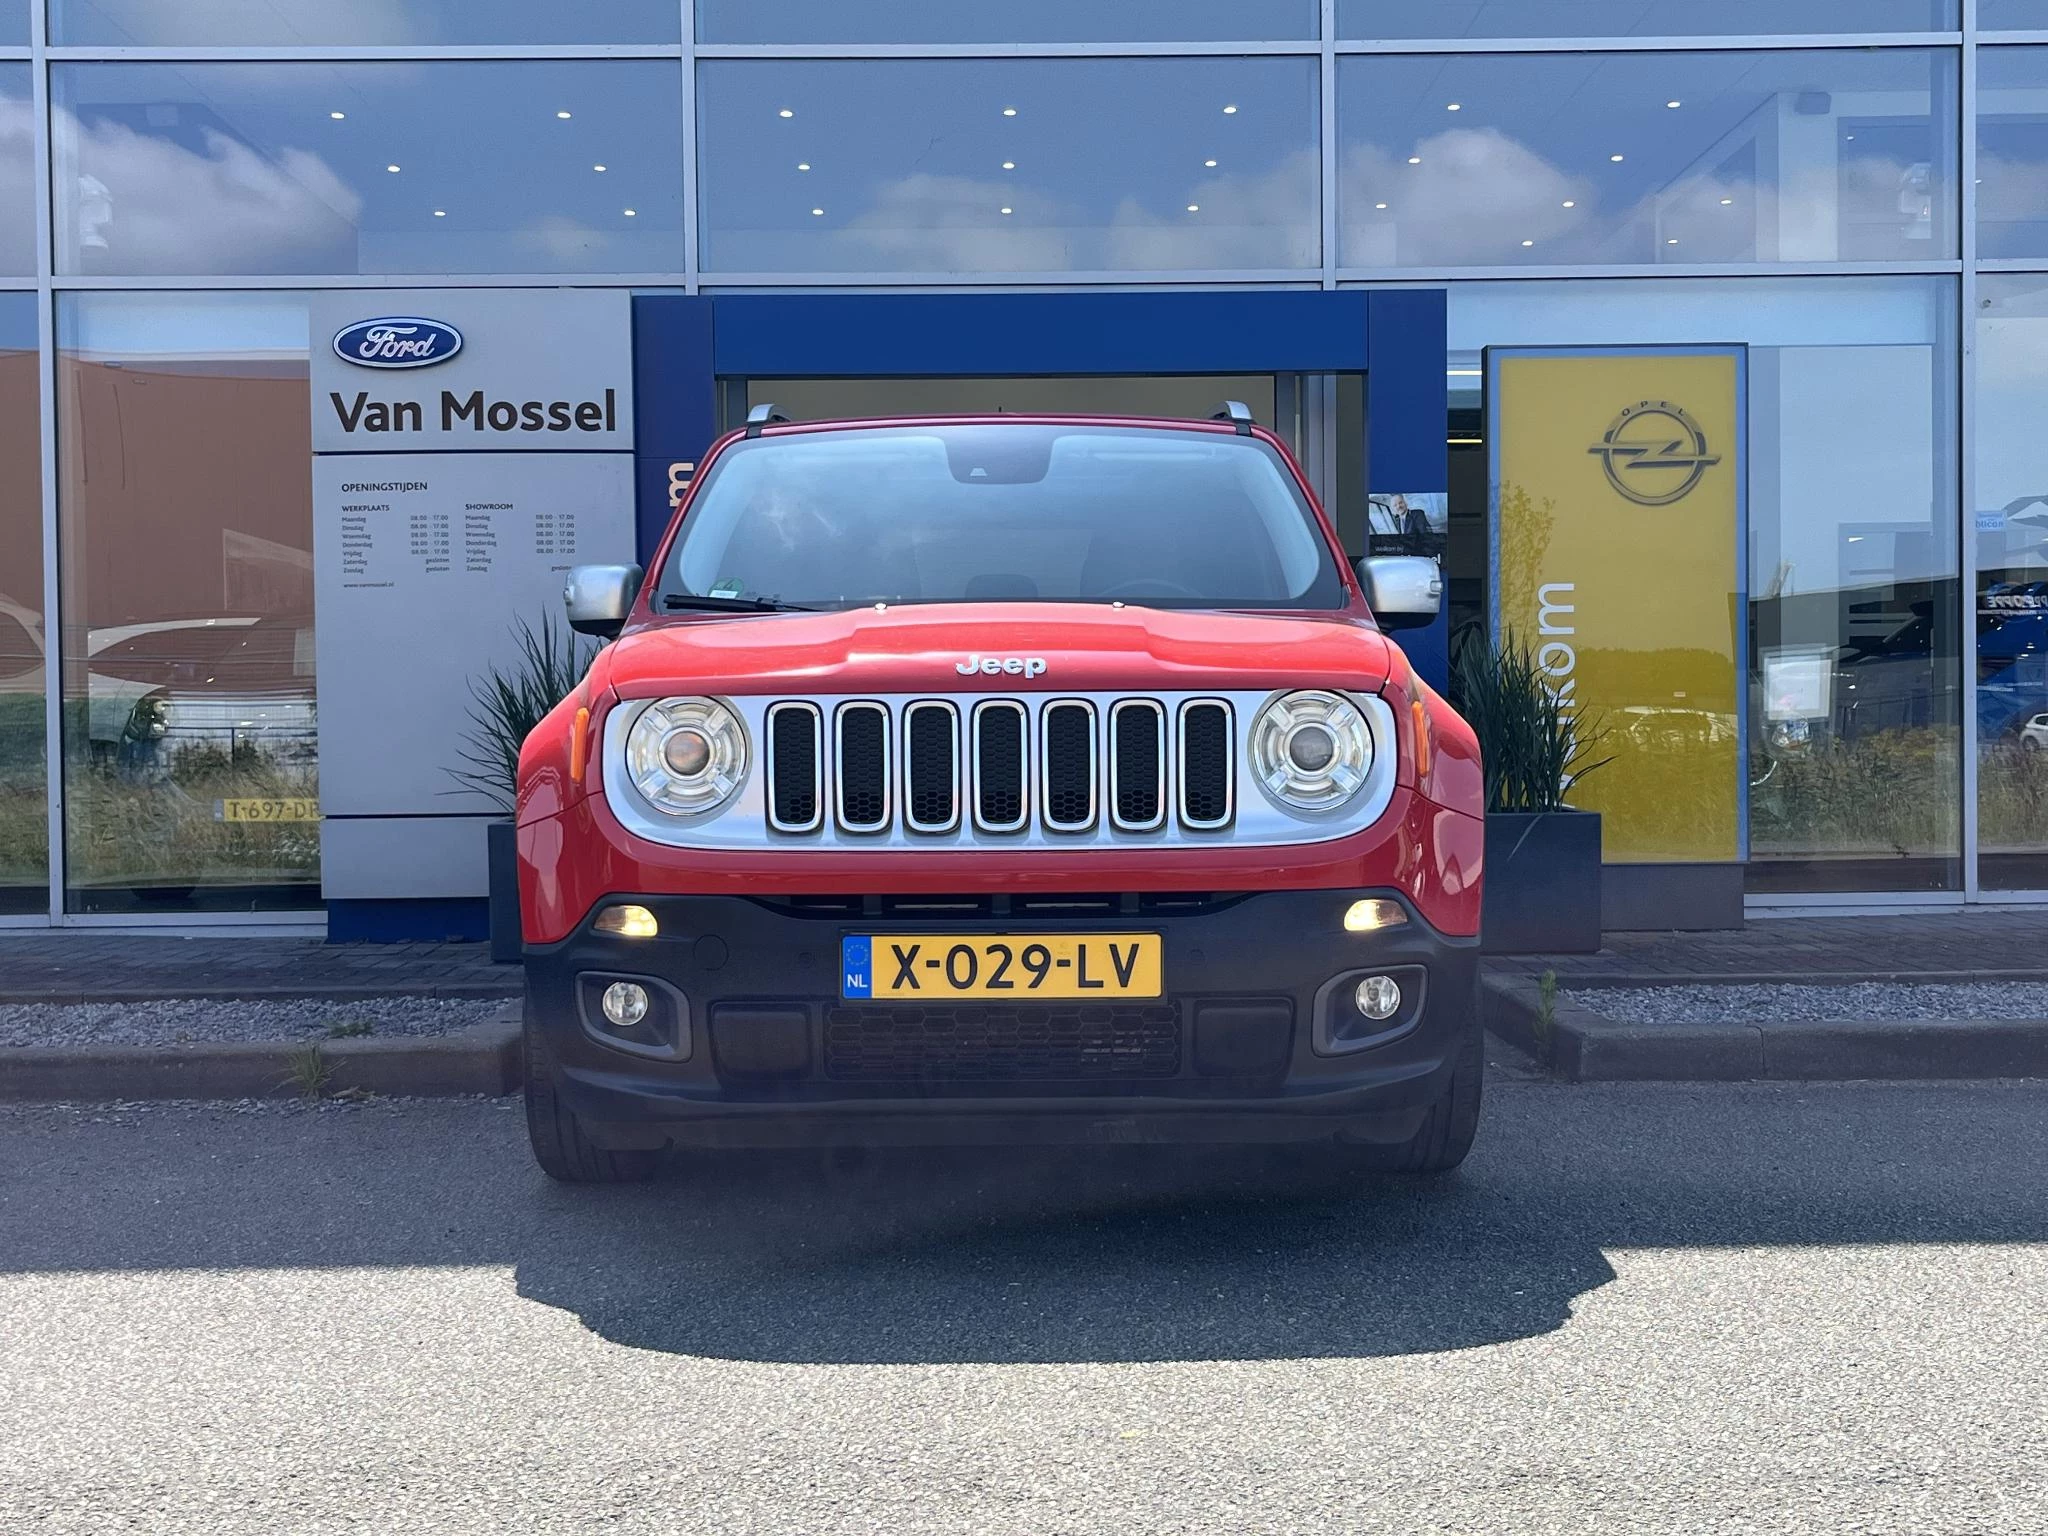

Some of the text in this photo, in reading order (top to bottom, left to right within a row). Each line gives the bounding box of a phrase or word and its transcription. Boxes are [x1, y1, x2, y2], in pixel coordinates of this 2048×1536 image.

[359, 326, 437, 358] Ford
[329, 388, 616, 433] Van Mossel
[1622, 400, 1686, 417] OPEL
[341, 482, 428, 493] OPENINGSTIJDEN
[341, 504, 390, 512] WERKPLAATS
[465, 503, 514, 511] SHOWROOM
[955, 654, 1048, 680] Jeep
[890, 943, 1140, 989] X-029-LV
[847, 974, 868, 988] NL
